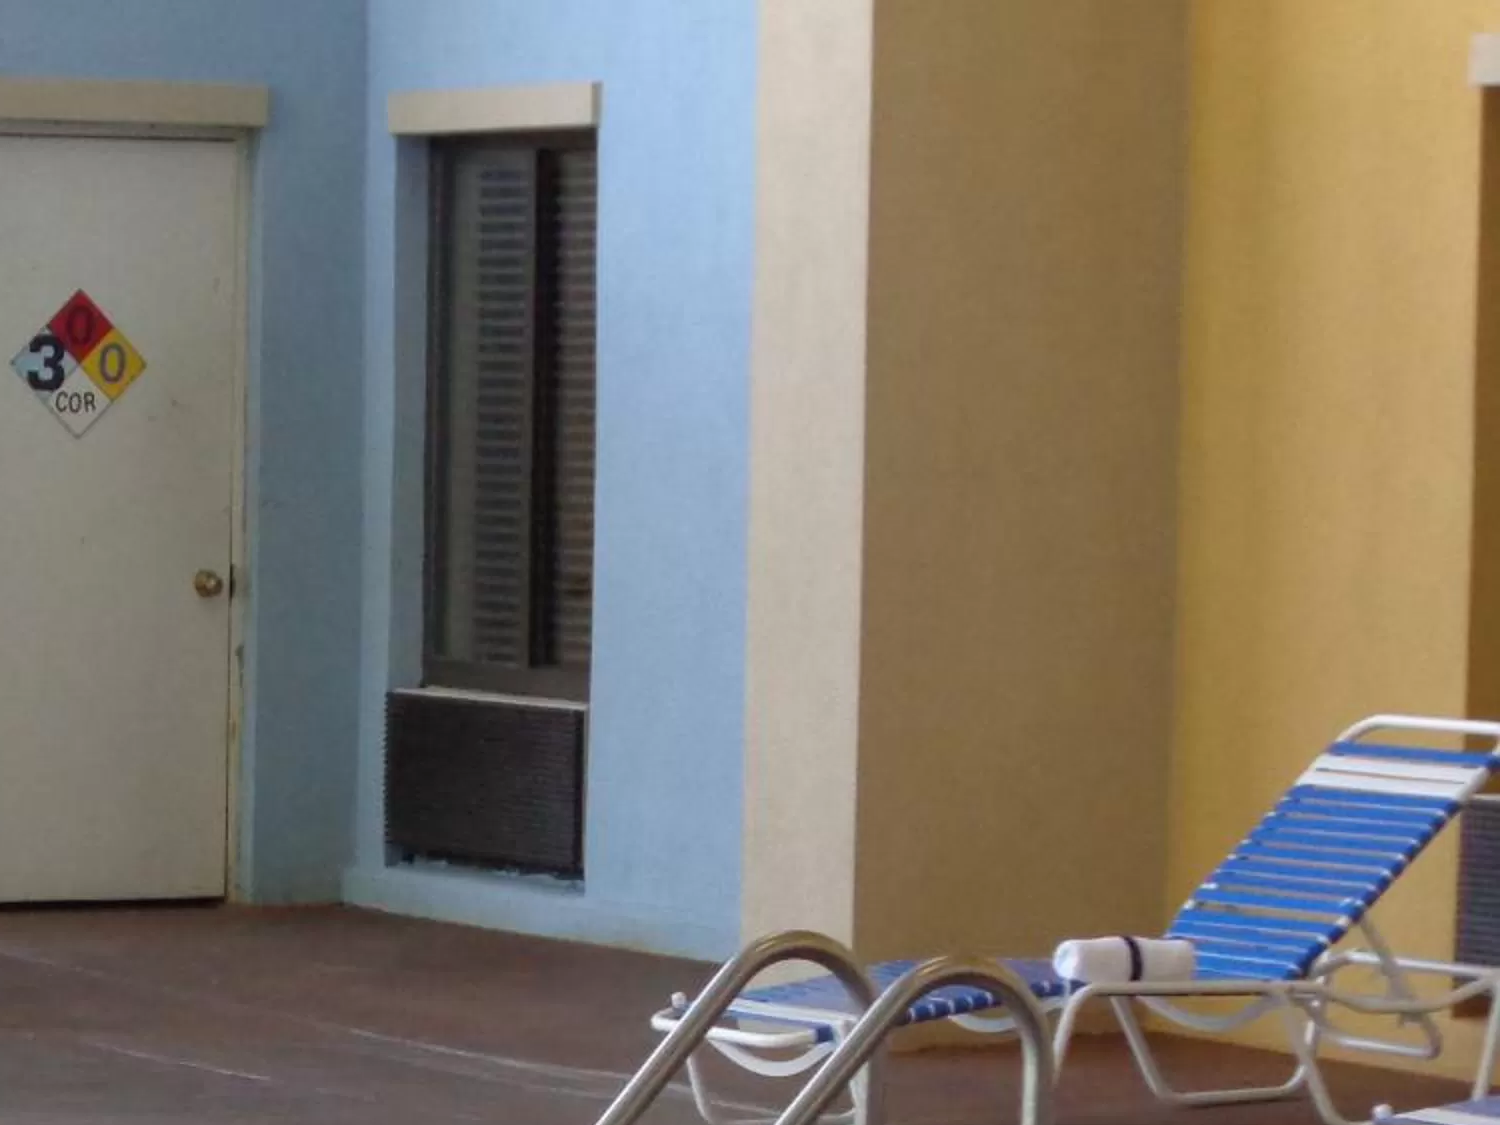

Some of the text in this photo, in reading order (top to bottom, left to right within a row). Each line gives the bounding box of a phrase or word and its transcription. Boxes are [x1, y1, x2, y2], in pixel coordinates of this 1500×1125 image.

[66, 307, 94, 345] 0
[27, 334, 66, 391] 3
[100, 342, 126, 385] 0
[55, 391, 97, 414] COR
